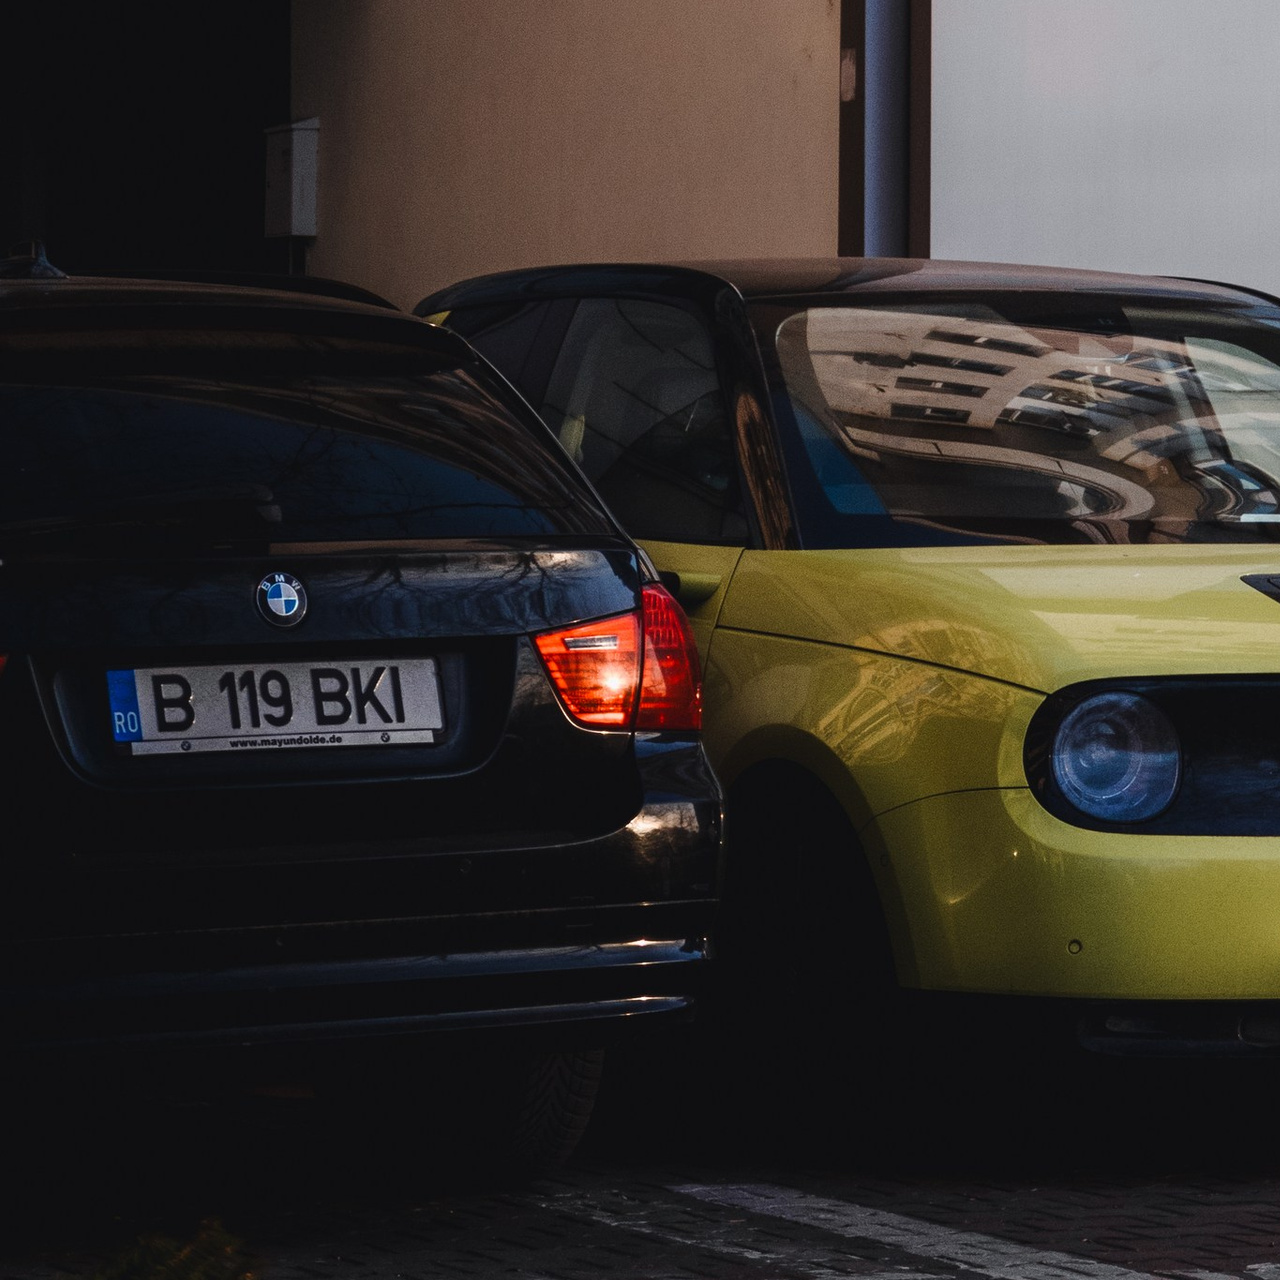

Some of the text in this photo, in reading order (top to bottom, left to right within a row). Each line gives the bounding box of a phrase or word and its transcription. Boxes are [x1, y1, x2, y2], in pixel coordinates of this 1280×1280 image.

[260, 573, 302, 592] BMW
[152, 666, 406, 733] B 119 BKI
[113, 711, 139, 734] RO
